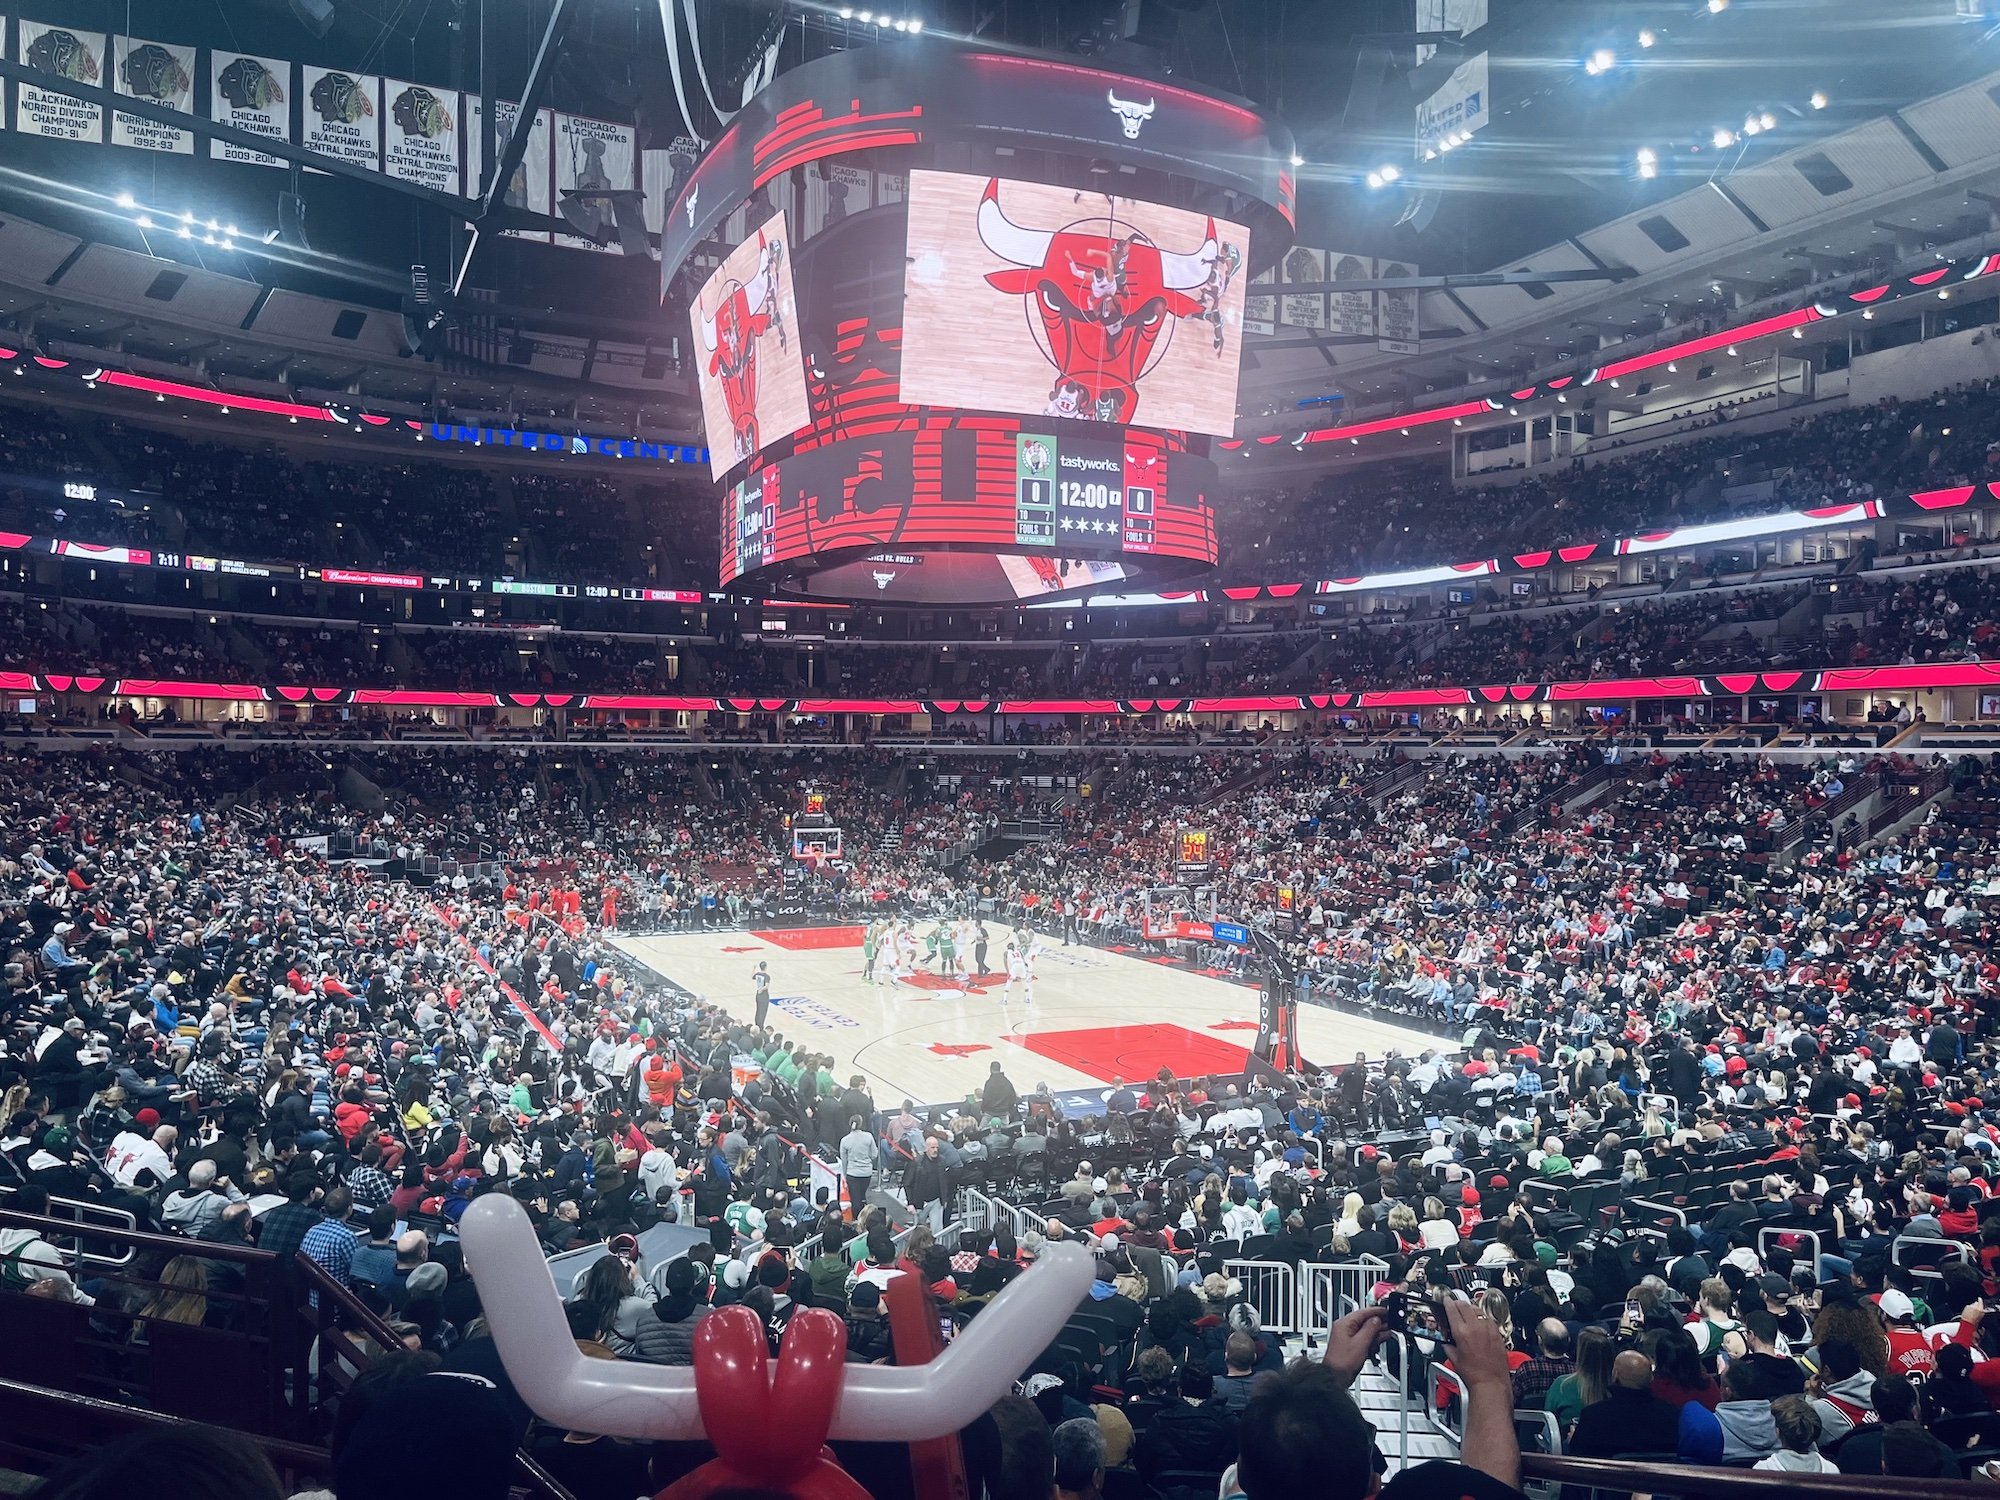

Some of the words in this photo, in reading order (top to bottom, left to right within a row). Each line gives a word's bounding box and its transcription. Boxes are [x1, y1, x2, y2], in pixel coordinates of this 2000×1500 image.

[28, 91, 94, 109] BLACKHAWKS
[22, 101, 57, 117] NORRIS
[59, 106, 99, 120] DIVISION
[232, 111, 270, 124] CHICAGO
[31, 113, 88, 130] CHAMPIONS
[573, 119, 617, 133] CHICAGO
[41, 125, 79, 139] 1990-91
[127, 126, 181, 141] CHAMPIONS
[322, 123, 360, 136] CHICAGO
[562, 125, 627, 143] BLACKHAWKS
[133, 137, 173, 150] 1992-93
[311, 132, 371, 148] BLACKHAWKS
[404, 137, 440, 150] CHICAGO
[225, 150, 276, 164] 2009-2010
[304, 141, 342, 155] CENTRAL
[345, 148, 378, 160] DIVISION
[393, 146, 451, 162] BLACKHAWKS
[386, 155, 424, 168] CENTRAL
[425, 161, 458, 173] DIVISION
[398, 167, 447, 182] CHAMPIONS
[432, 422, 564, 450] UNITED
[1060, 455, 1120, 472] tastyworks.
[64, 484, 94, 500] 12:00
[1032, 482, 1041, 502] 0
[1060, 482, 1107, 509] 12:00
[1136, 491, 1144, 511] 0
[1019, 510, 1028, 520] TO
[1045, 512, 1050, 521] 7
[1019, 524, 1039, 535] FOULS
[1045, 525, 1050, 535] 0
[1126, 518, 1133, 528] TO
[1148, 520, 1152, 530] 7
[1126, 531, 1142, 542] FOULS
[158, 553, 179, 567] 7:11
[896, 555, 914, 563] BULLS
[327, 571, 368, 582] Budweiser
[370, 576, 402, 585] CHAMPIONS
[403, 577, 417, 585] CLUB
[521, 583, 546, 594] BOSTON
[585, 586, 608, 597] 12:00
[807, 802, 820, 813] 24
[1183, 833, 1206, 845] 11:59
[1183, 845, 1203, 861] 24
[1467, 1280, 1488, 1292] LAVINE
[1898, 1348, 1932, 1369] PIPPE
